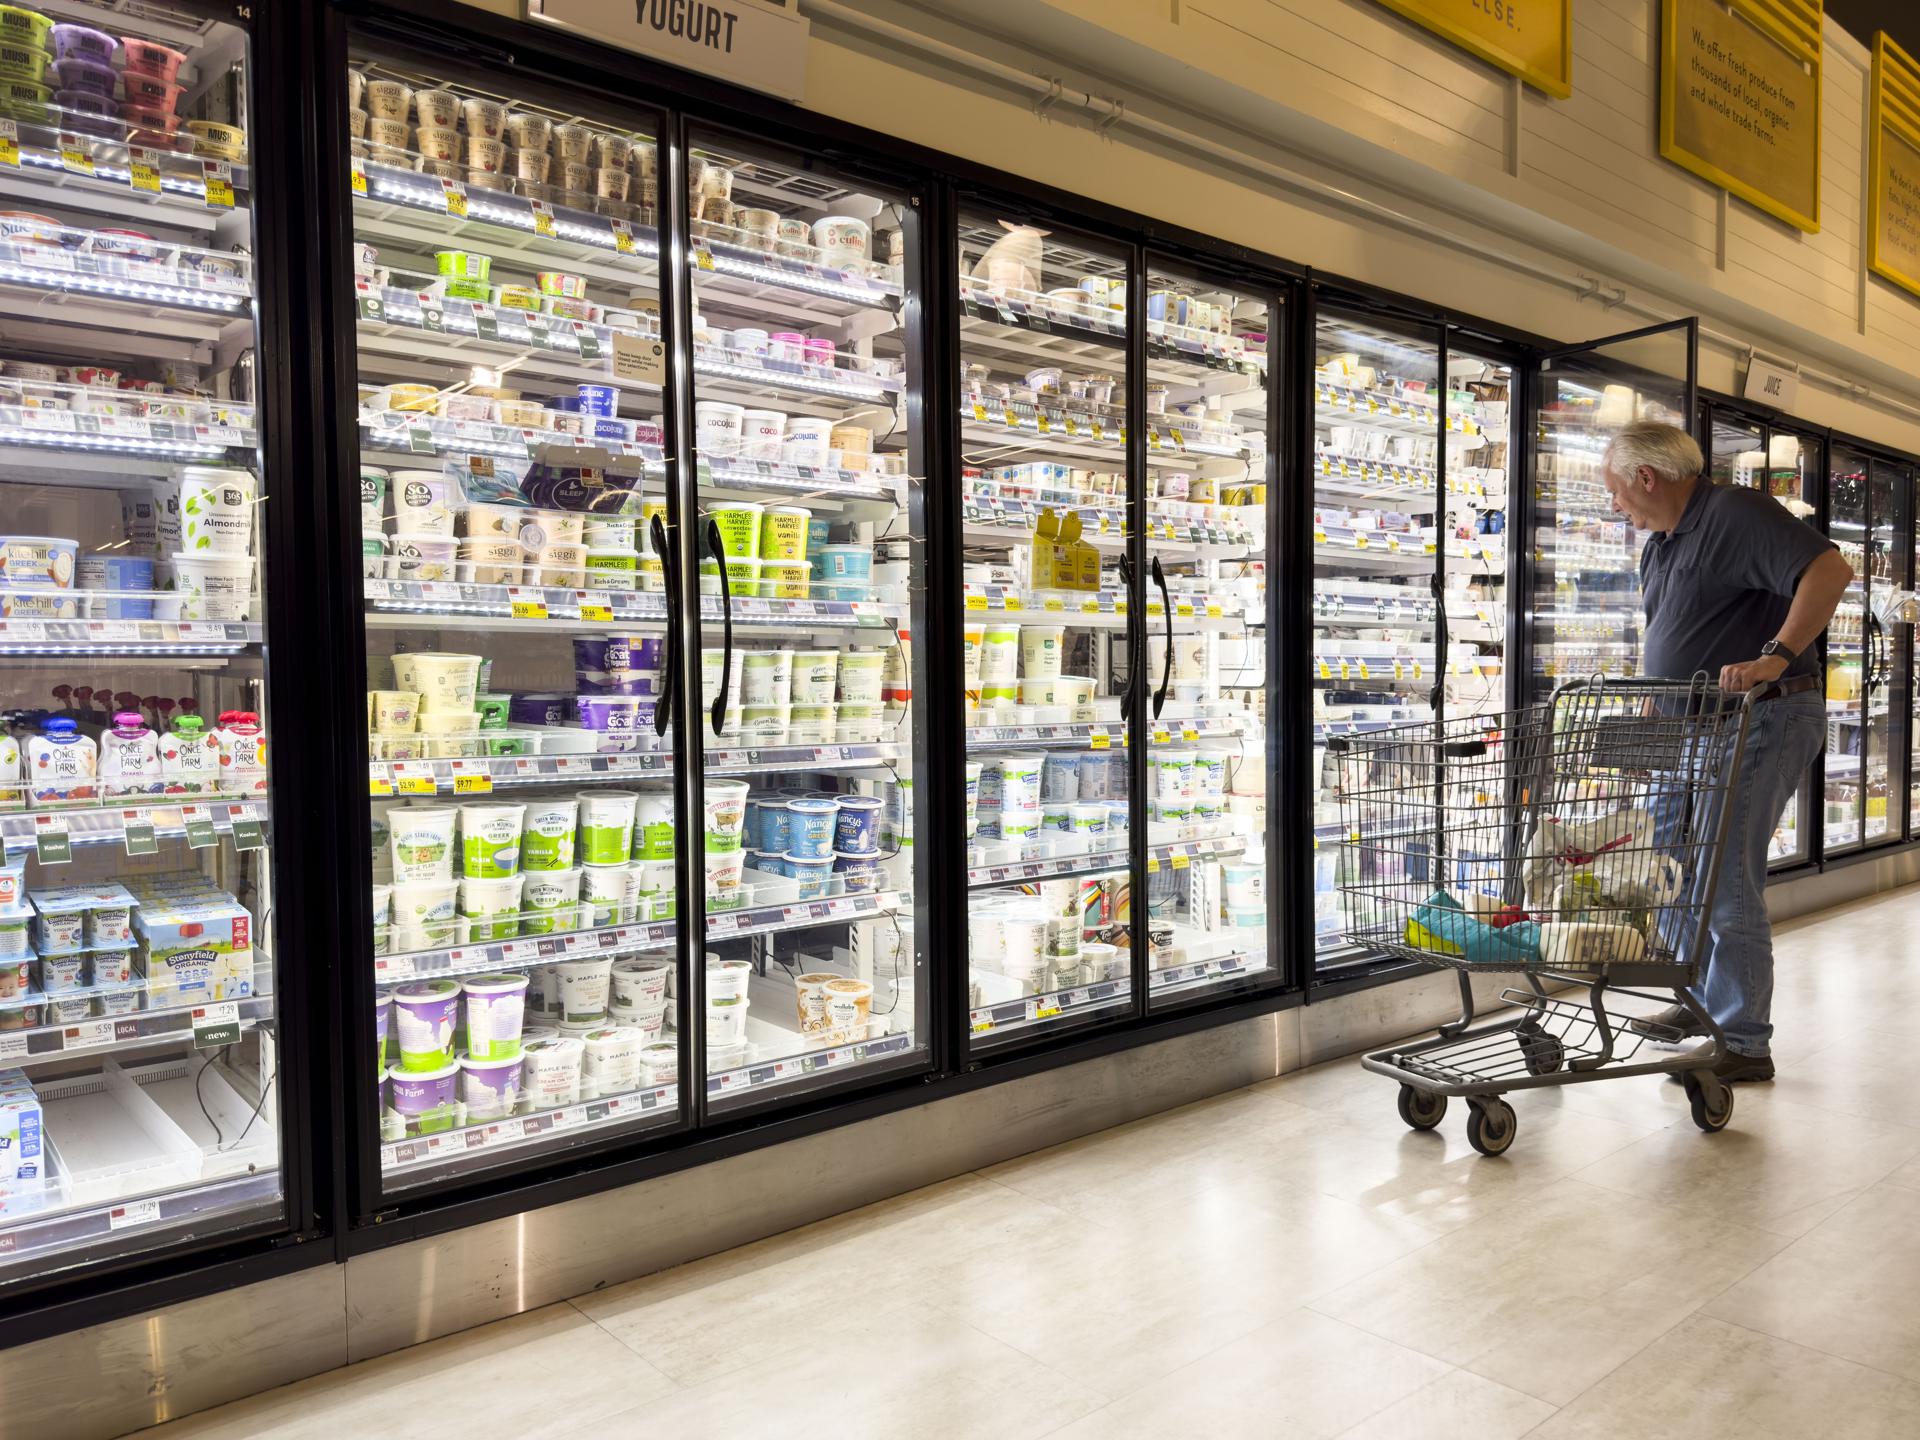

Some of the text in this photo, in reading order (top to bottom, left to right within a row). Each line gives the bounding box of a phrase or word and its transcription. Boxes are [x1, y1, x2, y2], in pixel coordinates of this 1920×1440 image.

[237, 5, 251, 19] 14
[3, 12, 31, 29] MUSH
[635, 0, 738, 53] YOGURT
[2, 48, 30, 64] MUSH
[1692, 27, 1796, 111] We offer fresh produce from
[11, 86, 38, 101] MUSH
[1692, 56, 1790, 131] thousands of local, organic
[1691, 86, 1777, 146] and whole trade farms.
[208, 128, 231, 143] MUSH
[912, 197, 920, 206] 15
[1764, 375, 1781, 396] JUICE
[407, 484, 428, 495] SO
[559, 489, 583, 498] SLEEP
[226, 492, 241, 501] 365
[608, 717, 633, 726] Goat
[119, 743, 142, 757] ONCE
[180, 744, 201, 755] ONCE
[235, 740, 256, 751] ONCE
[53, 748, 76, 760] ONCE
[235, 751, 255, 765] FARM
[55, 761, 77, 774] FARM
[121, 756, 144, 769] FARM
[181, 757, 202, 769] FARM
[457, 779, 472, 788] $9.77
[44, 844, 66, 852] Kosher
[49, 914, 79, 925] Stonyfield
[97, 911, 127, 920] Stonyfield
[52, 956, 81, 966] Stonyfield
[96, 953, 125, 961] Stonyfield
[168, 952, 215, 965] Stonyfield
[174, 961, 209, 970] ORGANIC
[834, 1003, 855, 1012] wallaby
[117, 1025, 137, 1035] LOCAL
[207, 1031, 228, 1040] new
[609, 1052, 630, 1060] MAPLE
[405, 1088, 424, 1098] Farm
[525, 1121, 539, 1129] LOCAL
[467, 1133, 482, 1142] LOCAL
